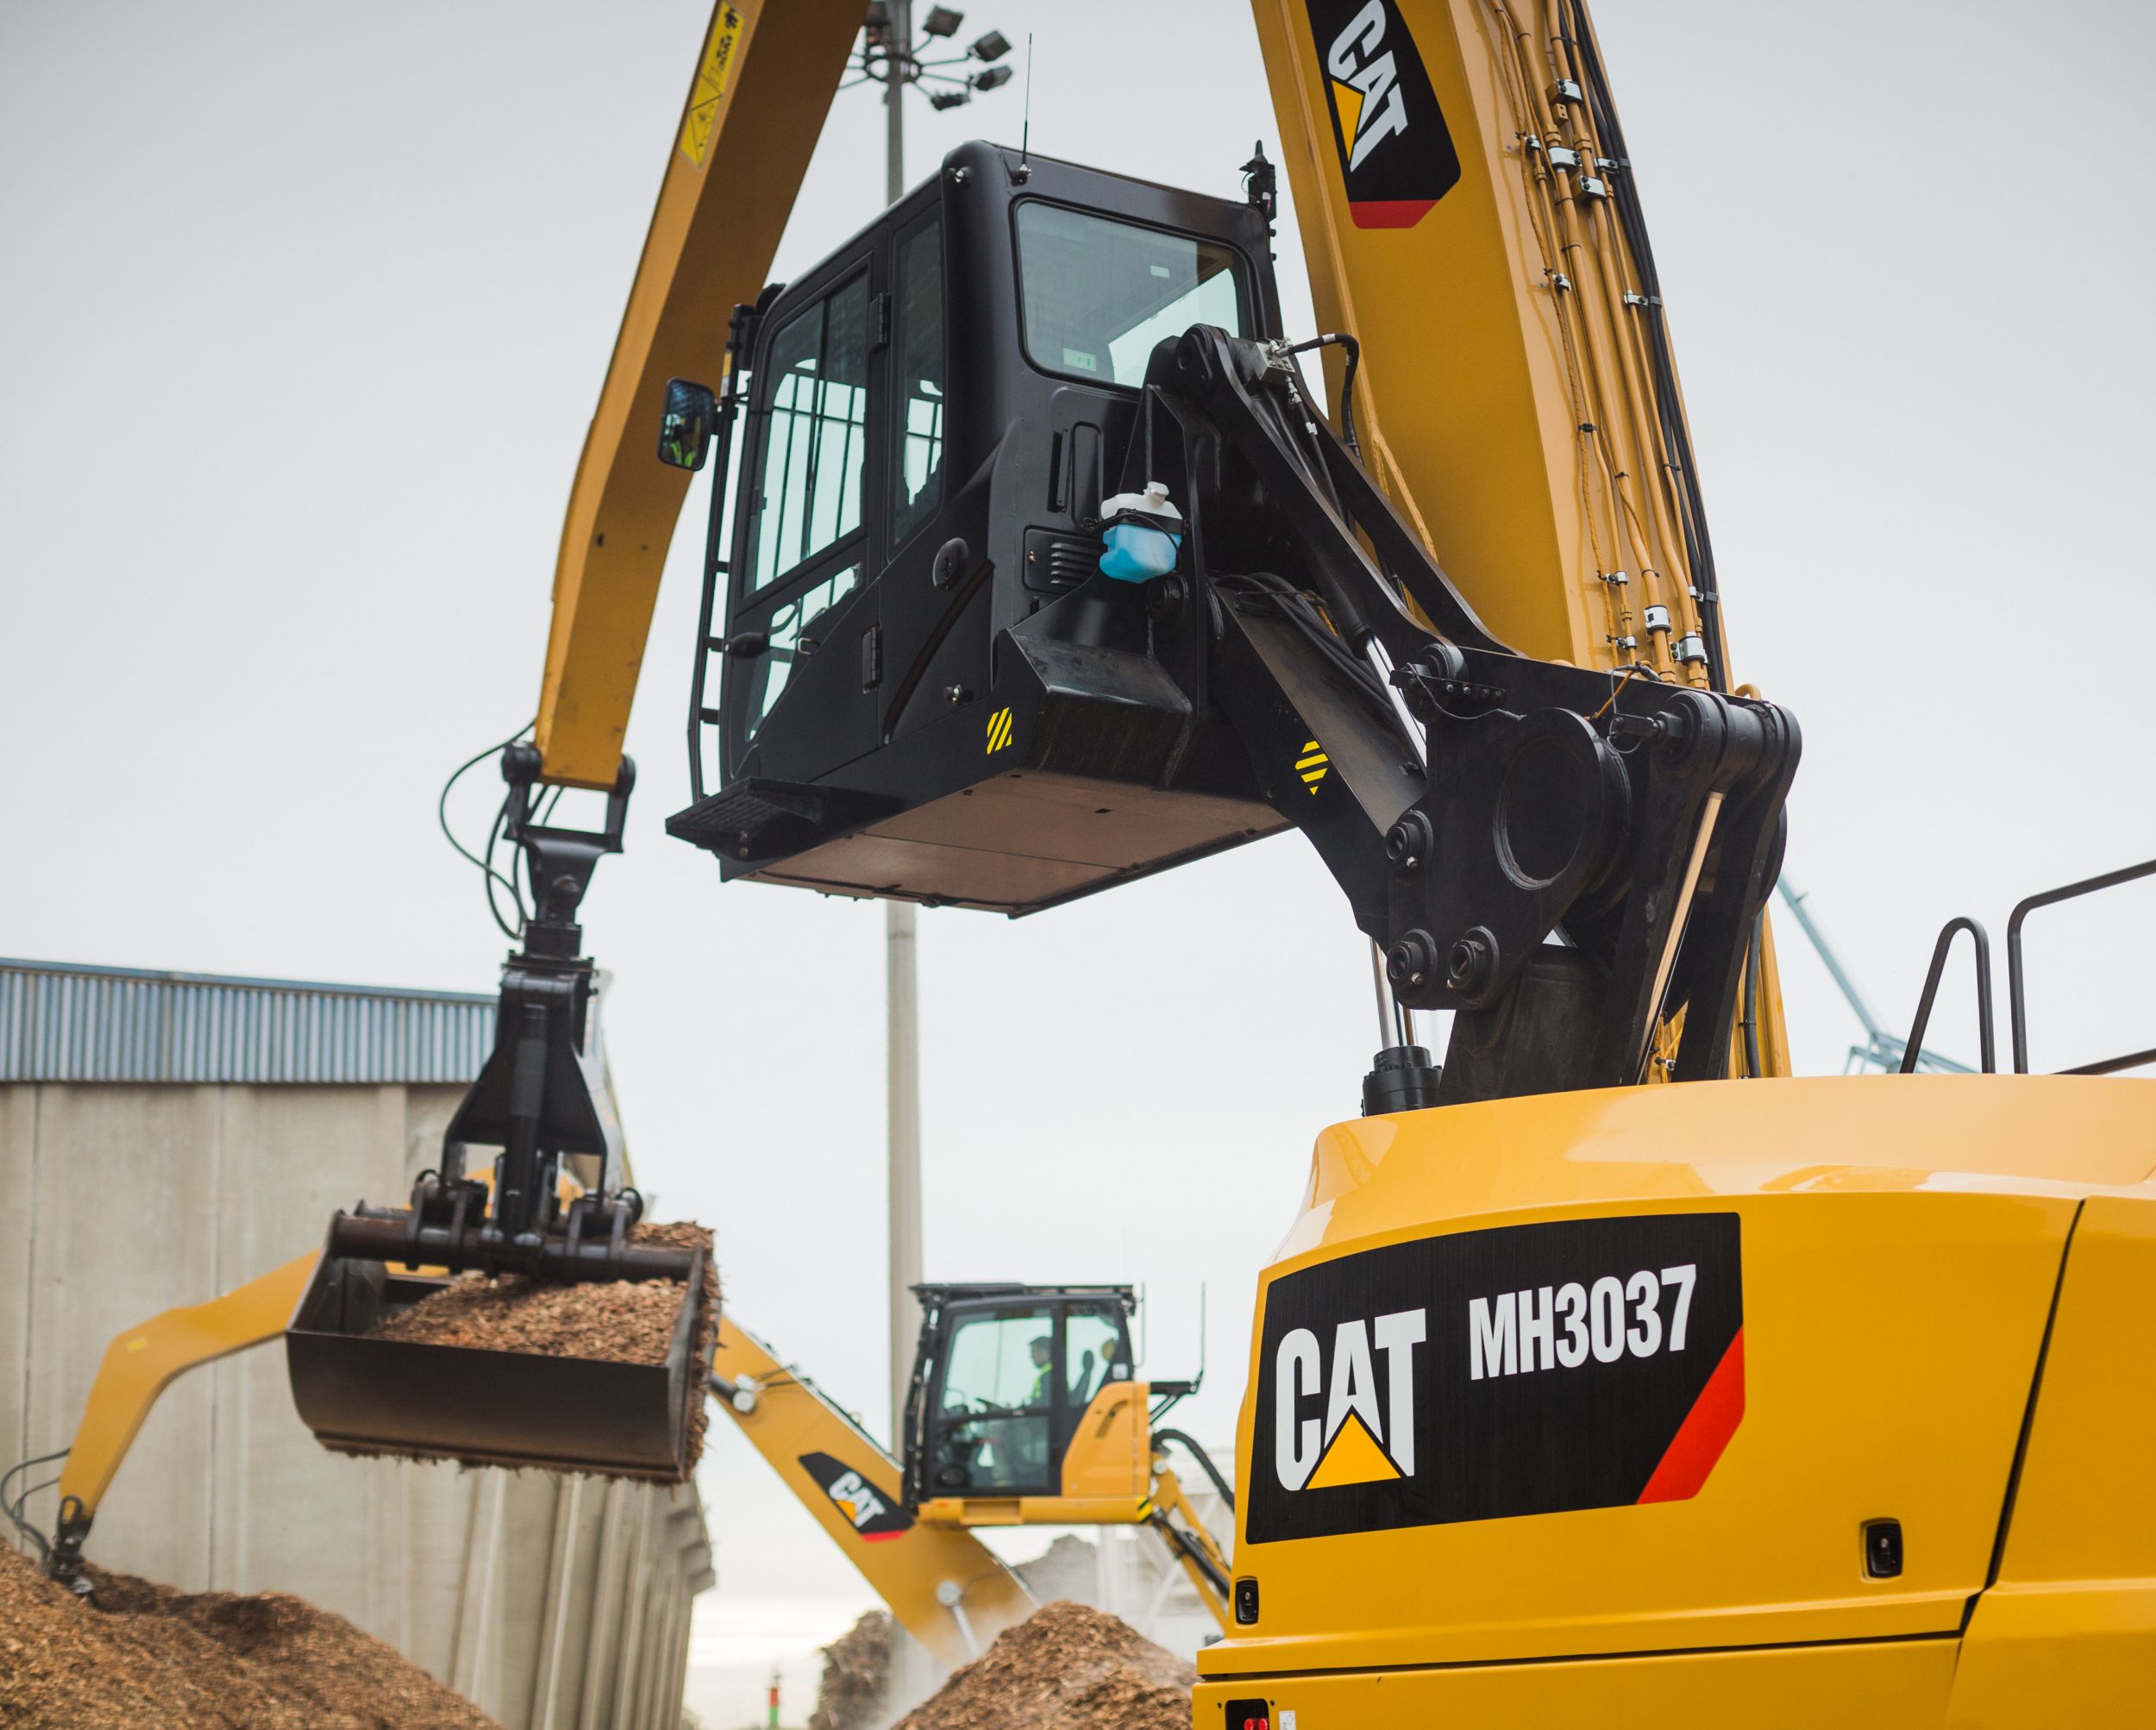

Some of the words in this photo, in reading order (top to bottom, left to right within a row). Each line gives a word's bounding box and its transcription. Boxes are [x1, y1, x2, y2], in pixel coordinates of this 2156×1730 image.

[1328, 0, 1408, 172] CAT
[1469, 1263, 1696, 1381] MH3037
[1275, 1307, 1426, 1492] CAT
[828, 1471, 886, 1528] CAT
